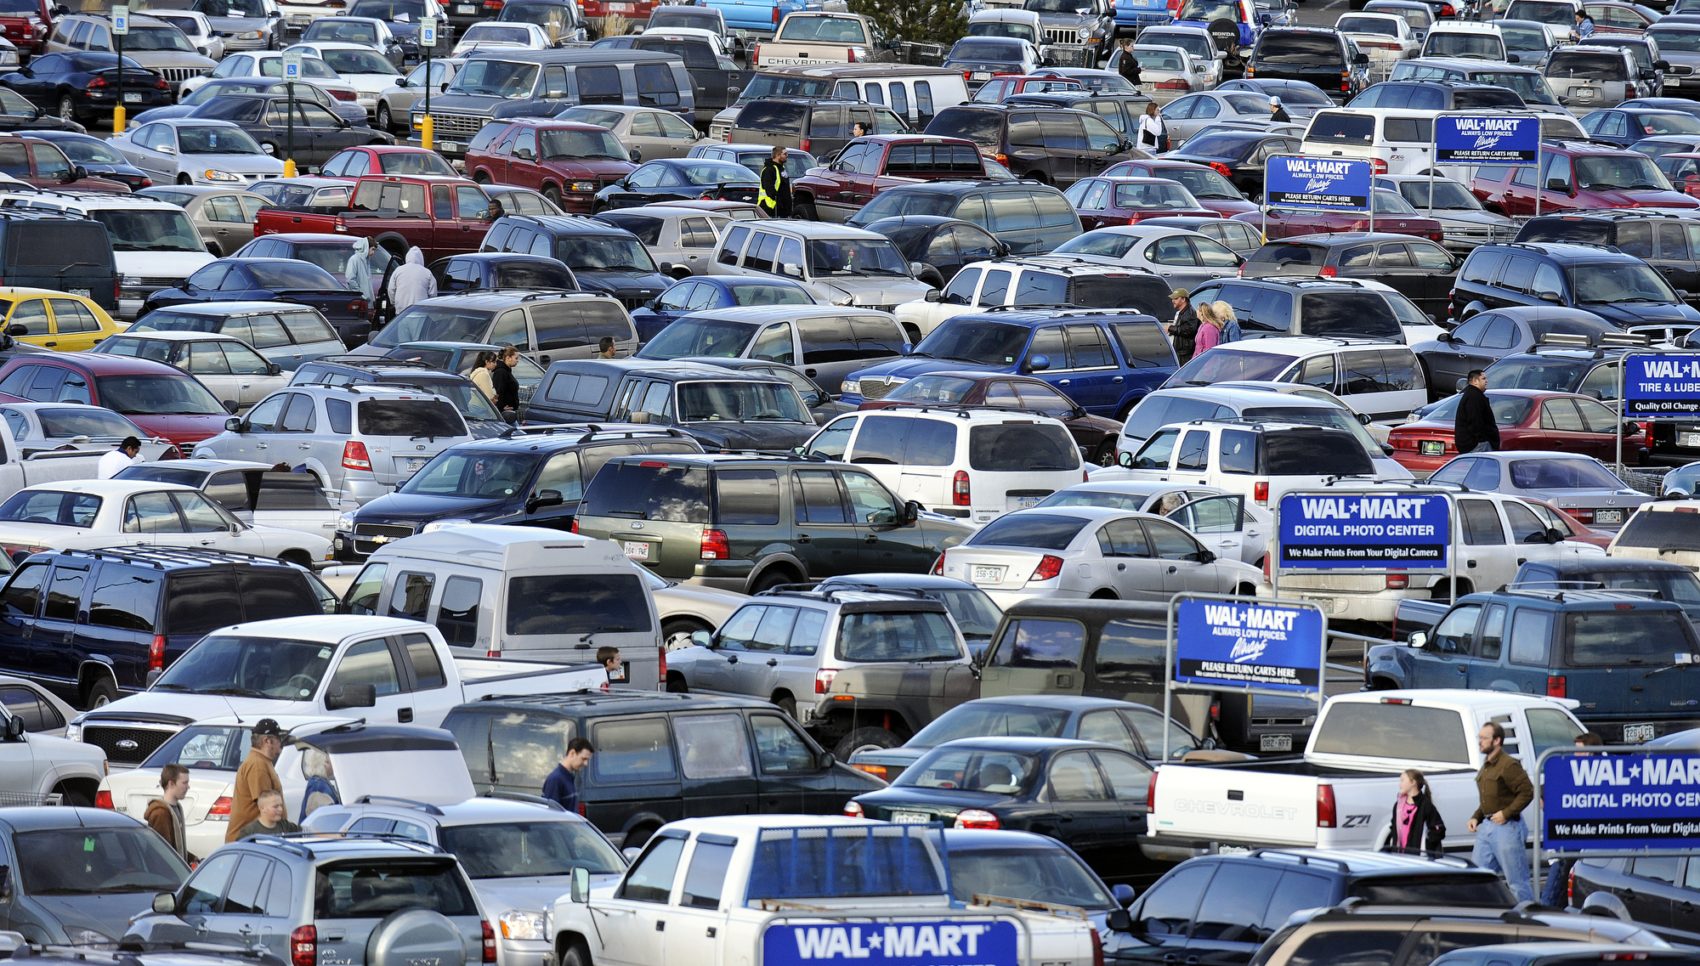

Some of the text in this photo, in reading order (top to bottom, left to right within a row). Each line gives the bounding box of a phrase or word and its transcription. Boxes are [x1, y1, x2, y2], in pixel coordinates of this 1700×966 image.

[1638, 383, 1700, 392] TIRE & LUBE
[1635, 402, 1660, 411] Quality
[1673, 402, 1698, 411] Change
[1294, 525, 1434, 536] DIGITAL PHOTO CENTER
[1385, 548, 1408, 558] Digital
[1410, 548, 1438, 557] Camera
[1212, 626, 1287, 640] ALWAYS LOW PRICES.
[1230, 637, 1268, 663] Always
[1202, 661, 1296, 678] PLEASE RETURN CARTS HERE
[1562, 794, 1618, 808] DIGITAL
[1622, 793, 1672, 807] PHOTO
[1174, 799, 1297, 820] CHEVROLET
[1342, 814, 1371, 828] Z71
[1555, 822, 1700, 836] We Make Prints From Your Digital
